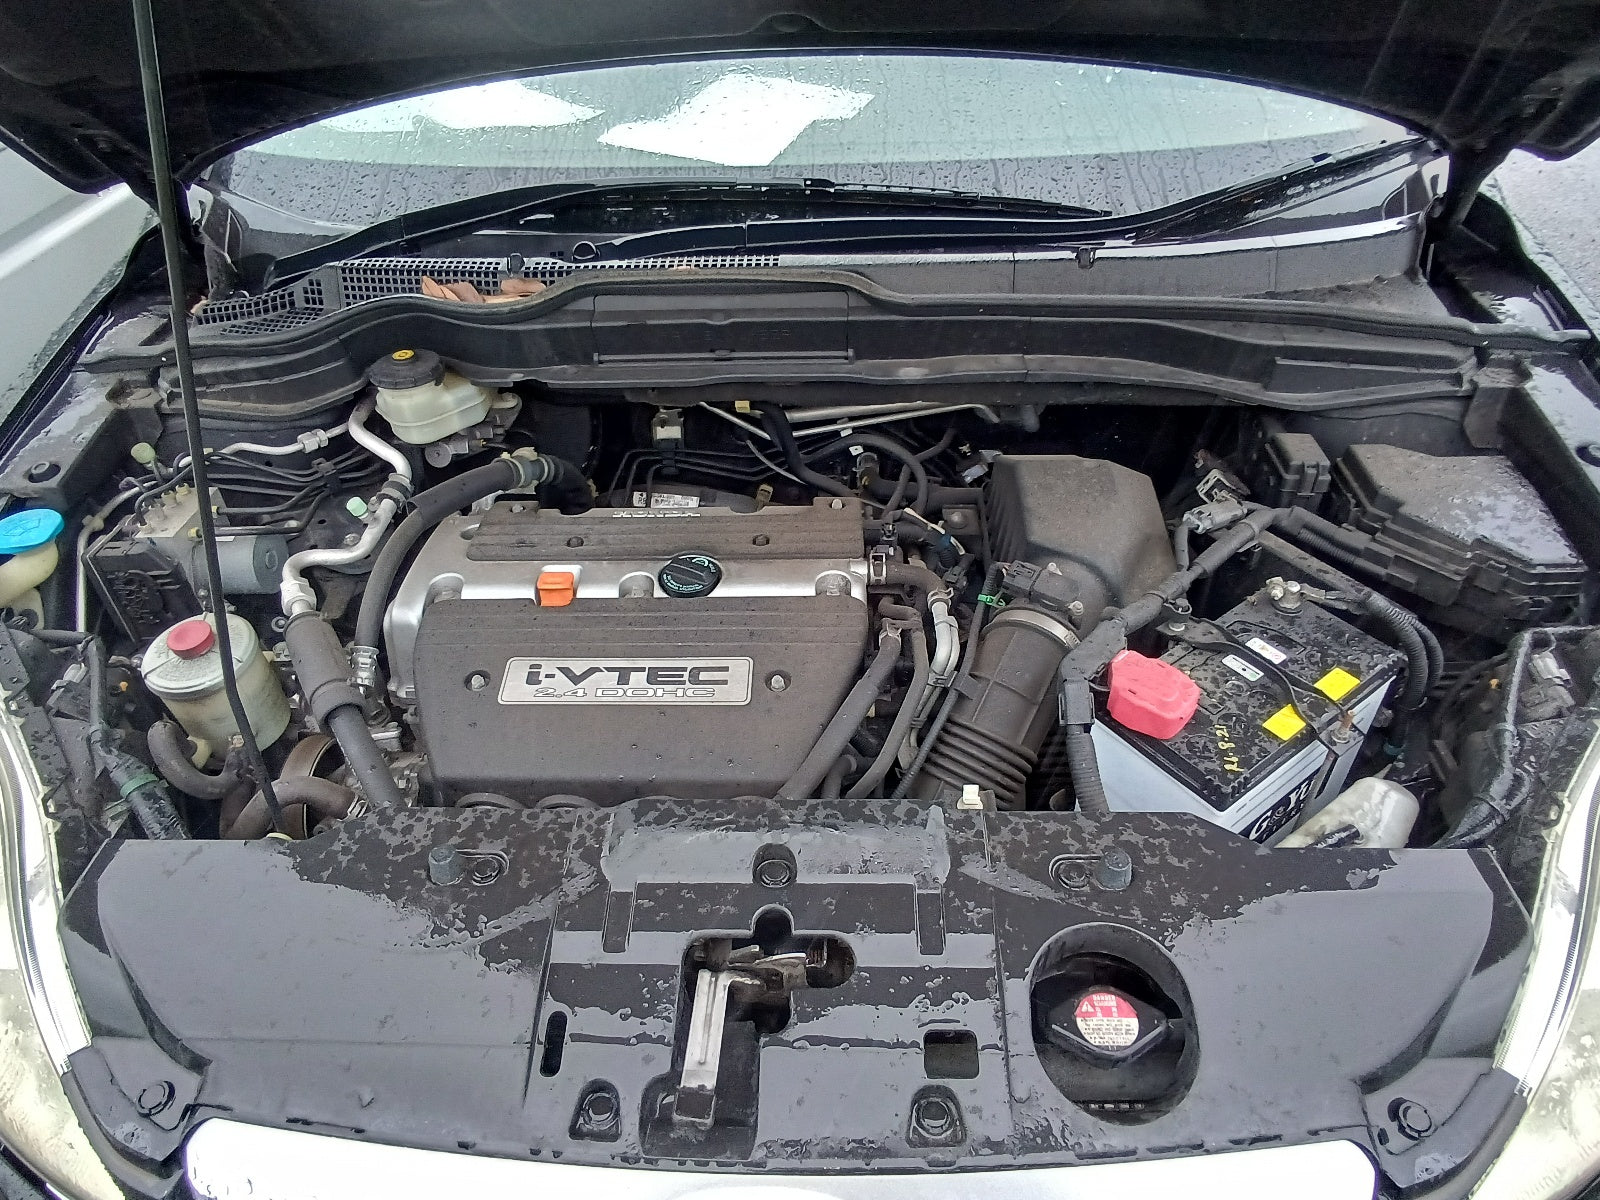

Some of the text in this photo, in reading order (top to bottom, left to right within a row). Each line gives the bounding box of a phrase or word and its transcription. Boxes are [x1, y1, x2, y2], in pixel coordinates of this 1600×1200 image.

[525, 663, 730, 686] i-VTEC
[533, 687, 716, 698] 2.4 DOHC
